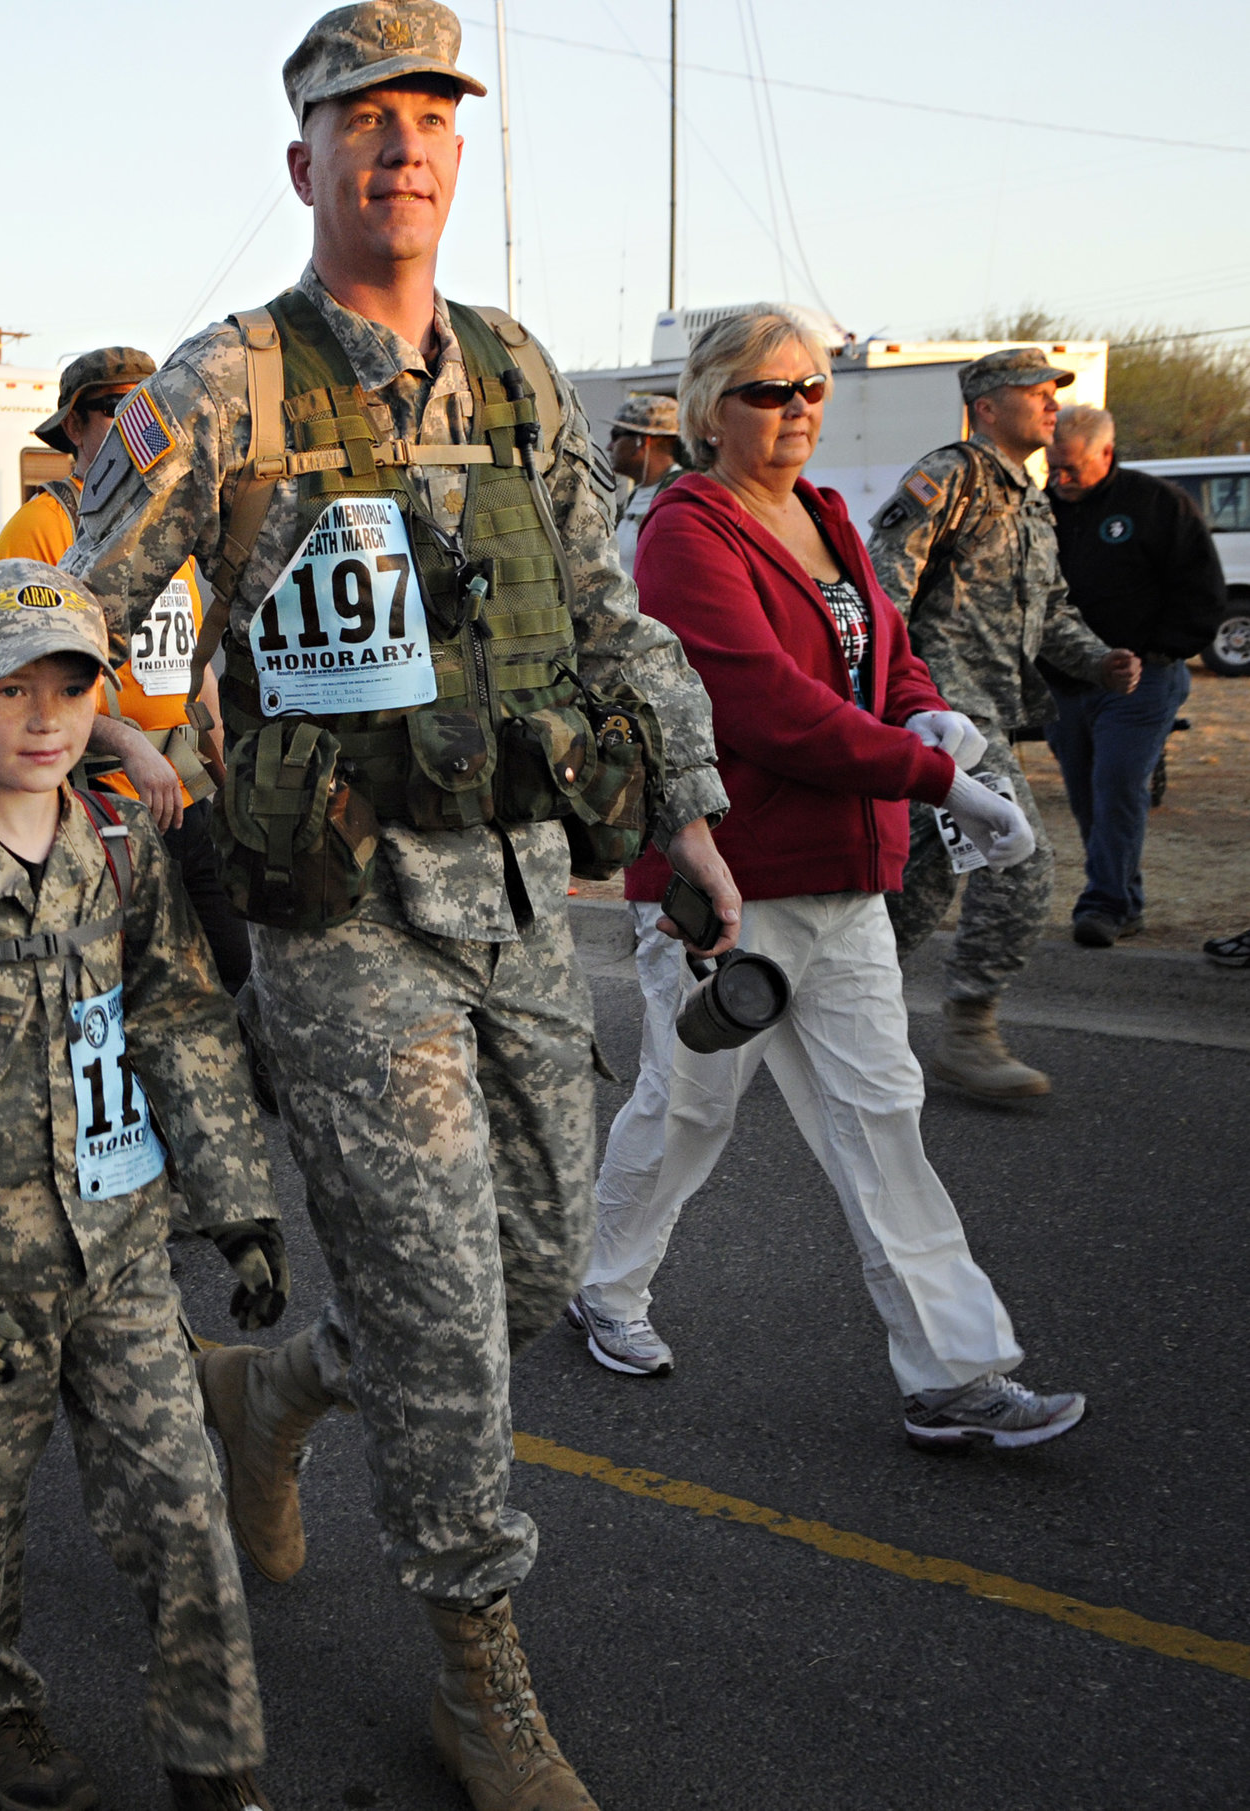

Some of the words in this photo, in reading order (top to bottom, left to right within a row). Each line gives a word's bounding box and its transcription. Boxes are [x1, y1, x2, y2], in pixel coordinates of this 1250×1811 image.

[333, 504, 391, 529] MEMORIAL
[342, 527, 386, 553] MARCH
[23, 586, 57, 607] ARMY
[258, 553, 410, 651] 1197
[266, 642, 416, 671] HONORARY
